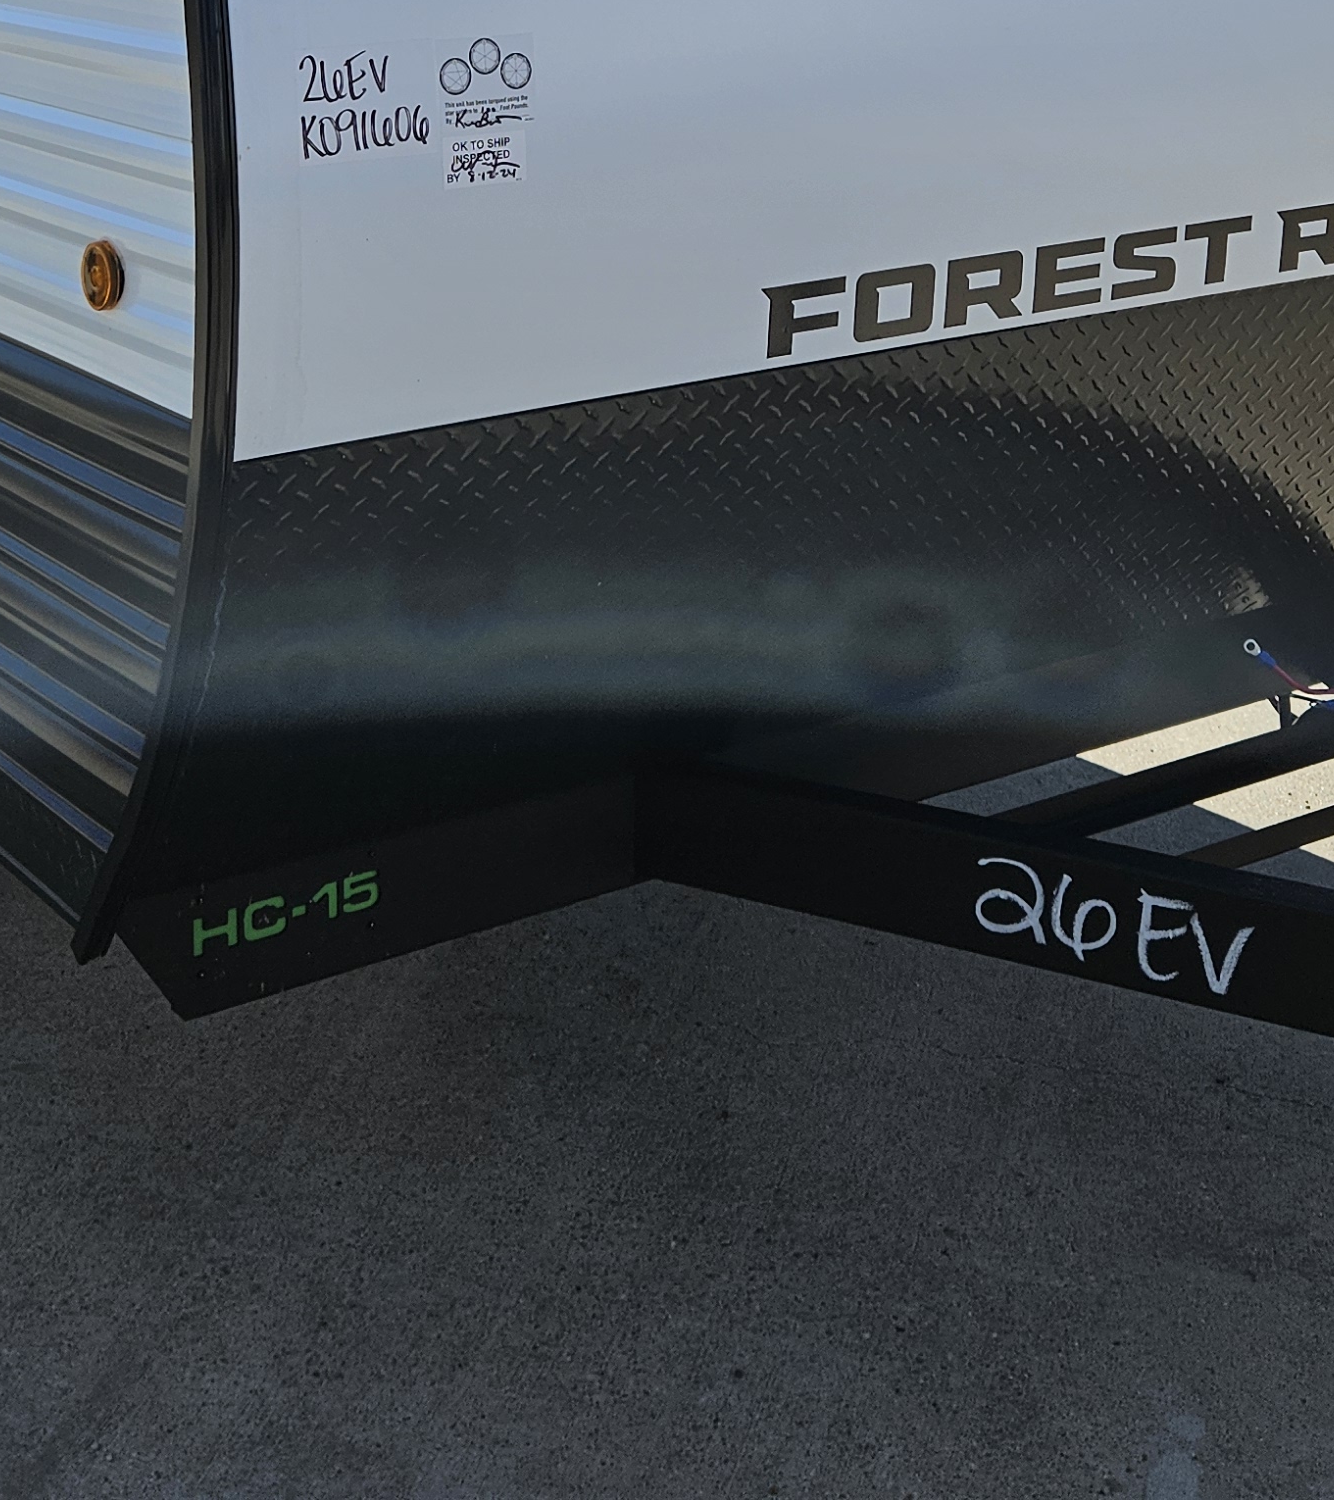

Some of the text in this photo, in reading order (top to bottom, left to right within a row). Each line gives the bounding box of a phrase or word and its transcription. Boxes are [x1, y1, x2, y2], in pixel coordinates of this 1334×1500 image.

[299, 50, 389, 102] 26EV
[452, 137, 510, 152] OK TO SHIP
[453, 150, 510, 164] INSPECTED
[447, 173, 460, 183] BY
[762, 215, 1253, 359] FOREST
[193, 870, 379, 957] HC-15
